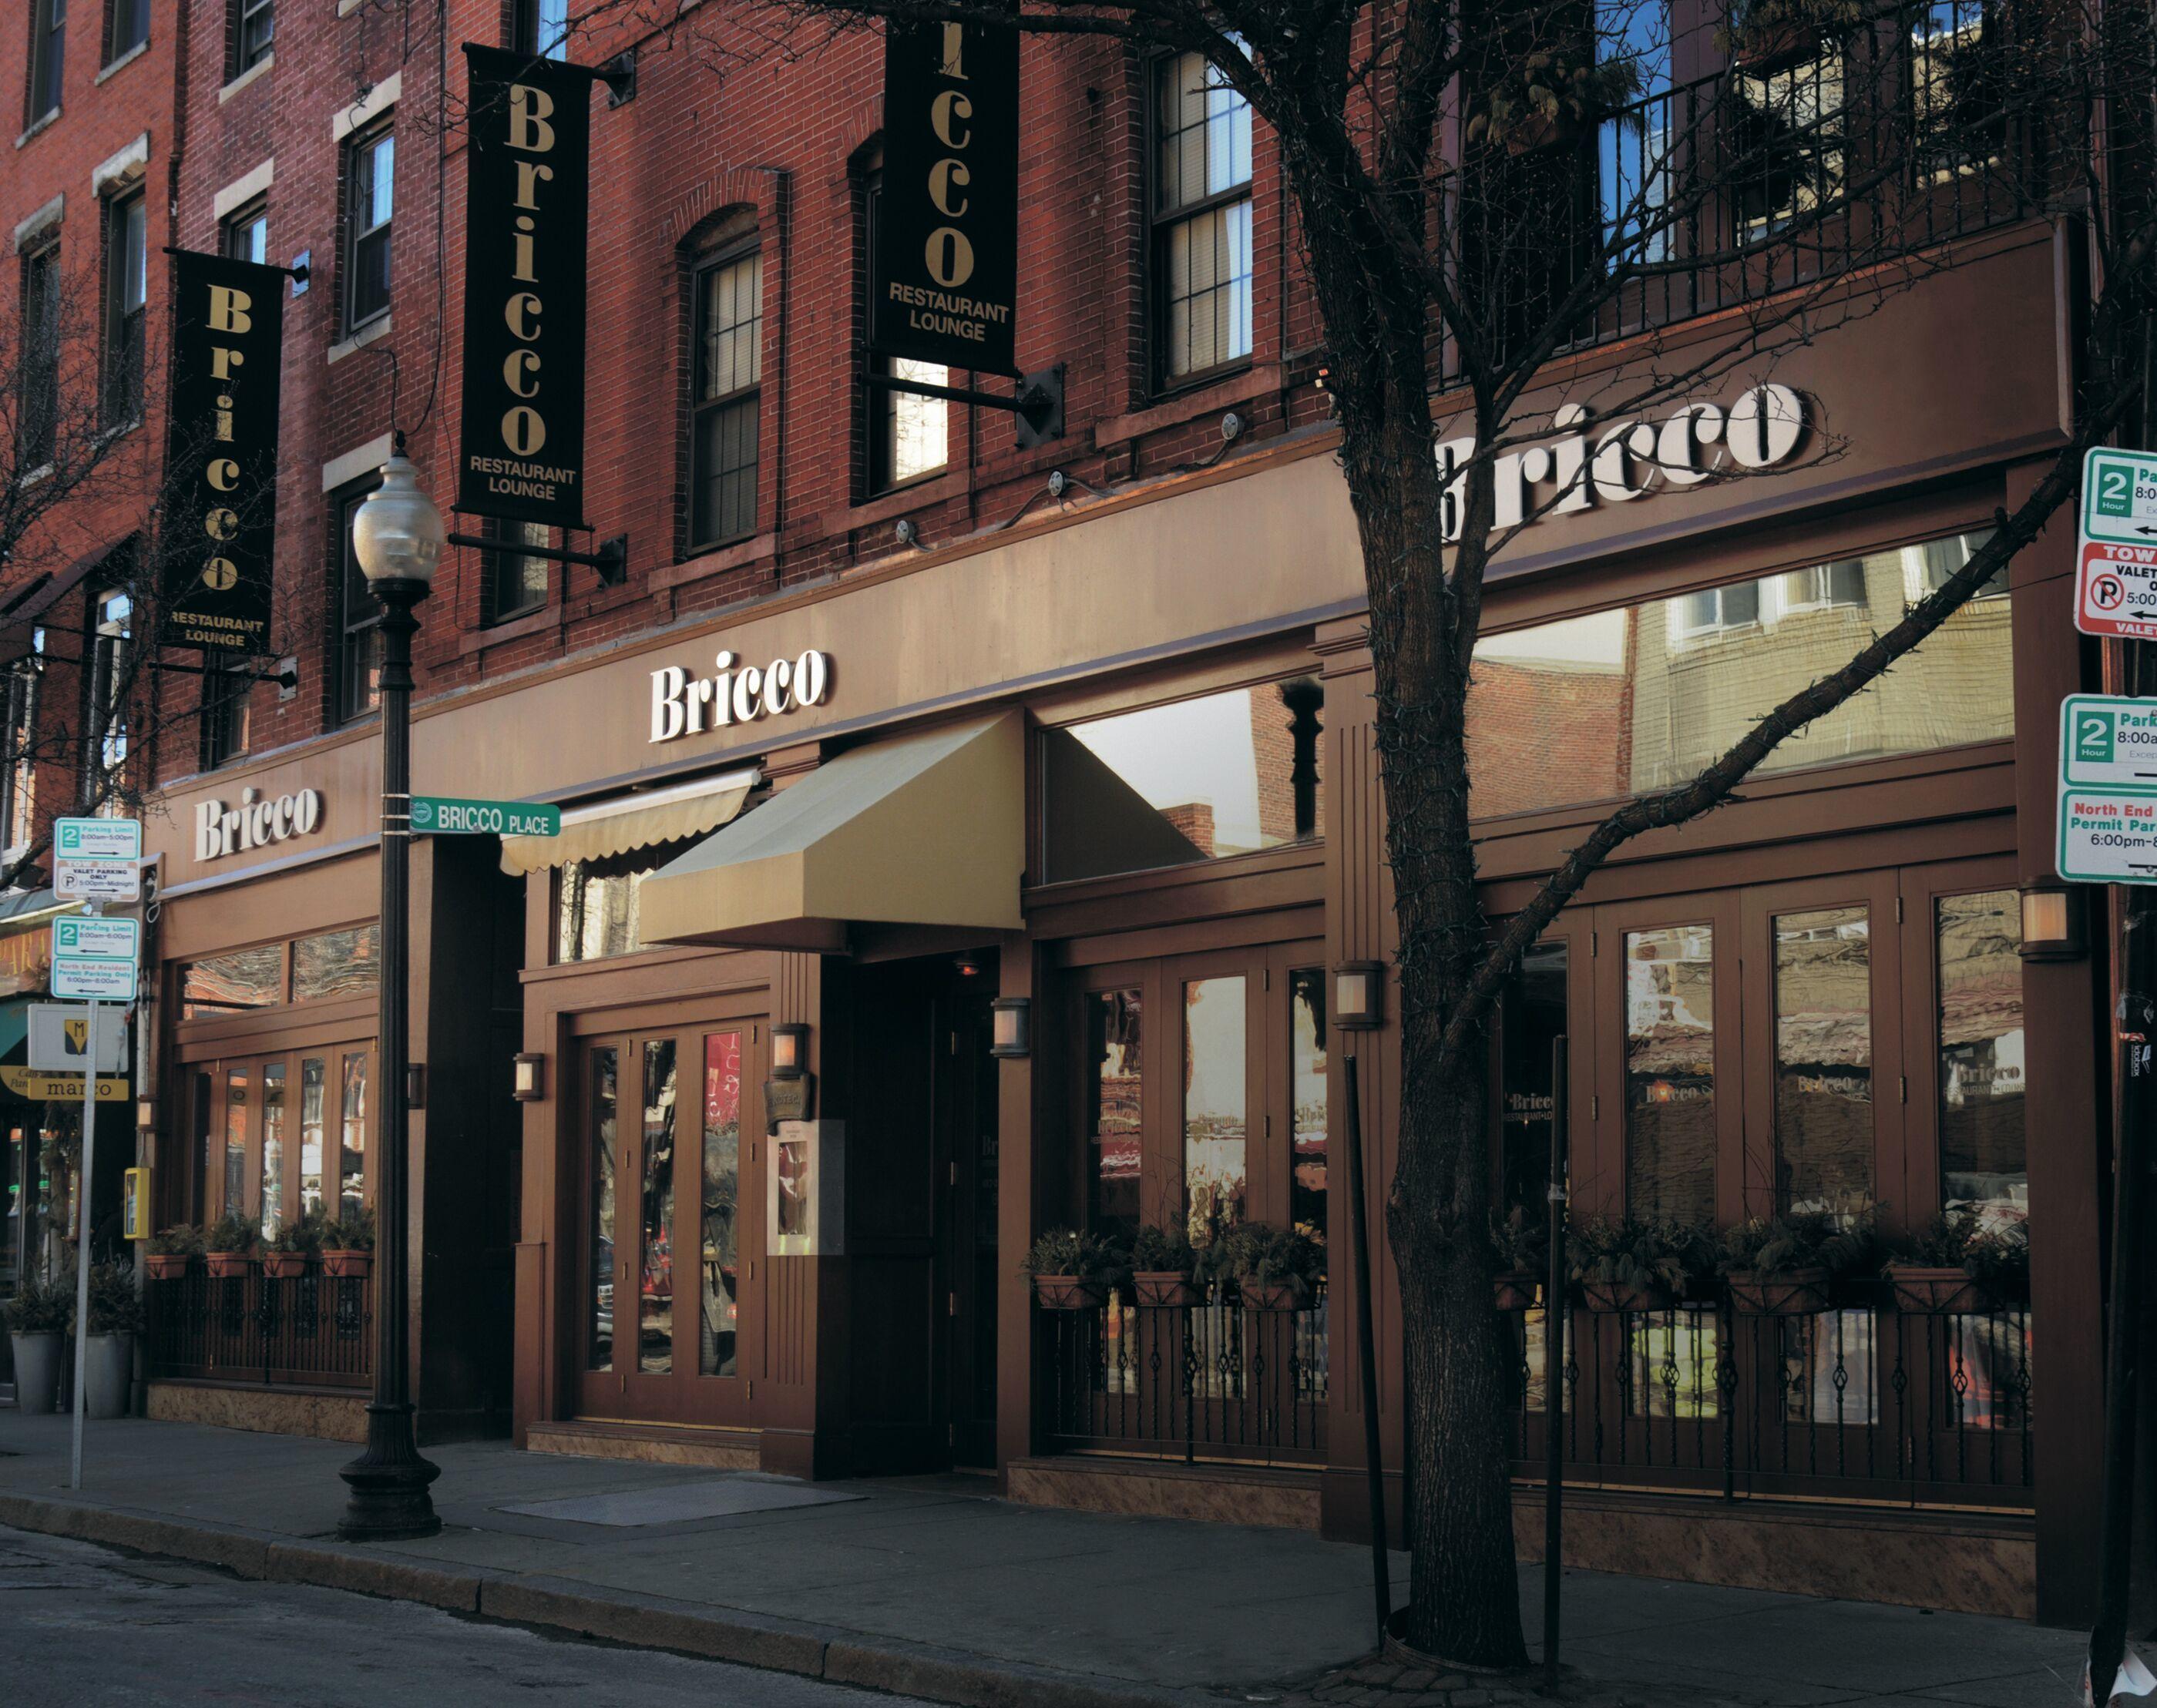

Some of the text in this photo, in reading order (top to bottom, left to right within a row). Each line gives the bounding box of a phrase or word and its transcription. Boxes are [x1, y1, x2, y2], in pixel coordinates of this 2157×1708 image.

[501, 84, 556, 457] Bricco
[889, 281, 1010, 324] RESTAURANT
[909, 310, 986, 342] LOUNGE
[202, 284, 253, 591] Bricco
[470, 455, 576, 485] RESTAURANT
[489, 476, 548, 501] LOUNGE
[2102, 471, 2127, 500] 2
[2102, 502, 2125, 510] Hour
[2103, 545, 2155, 562] TOW
[2116, 565, 2157, 579] VALET
[171, 611, 264, 633] RESTAURANT
[2115, 622, 2157, 636] VALE
[185, 629, 246, 646] LOUNGE
[648, 649, 827, 743] Bricco
[2081, 719, 2108, 746] 2
[438, 805, 502, 832] BRICCO
[509, 815, 549, 834] PLACE
[2075, 802, 2153, 817] North End
[193, 786, 318, 862] Bricco
[2071, 817, 2157, 832] Permit Par
[64, 828, 77, 841] 2
[62, 926, 76, 940] 2
[74, 1022, 85, 1038] M
[47, 1082, 112, 1096] maro
[1512, 1092, 1554, 1110] Bricc
